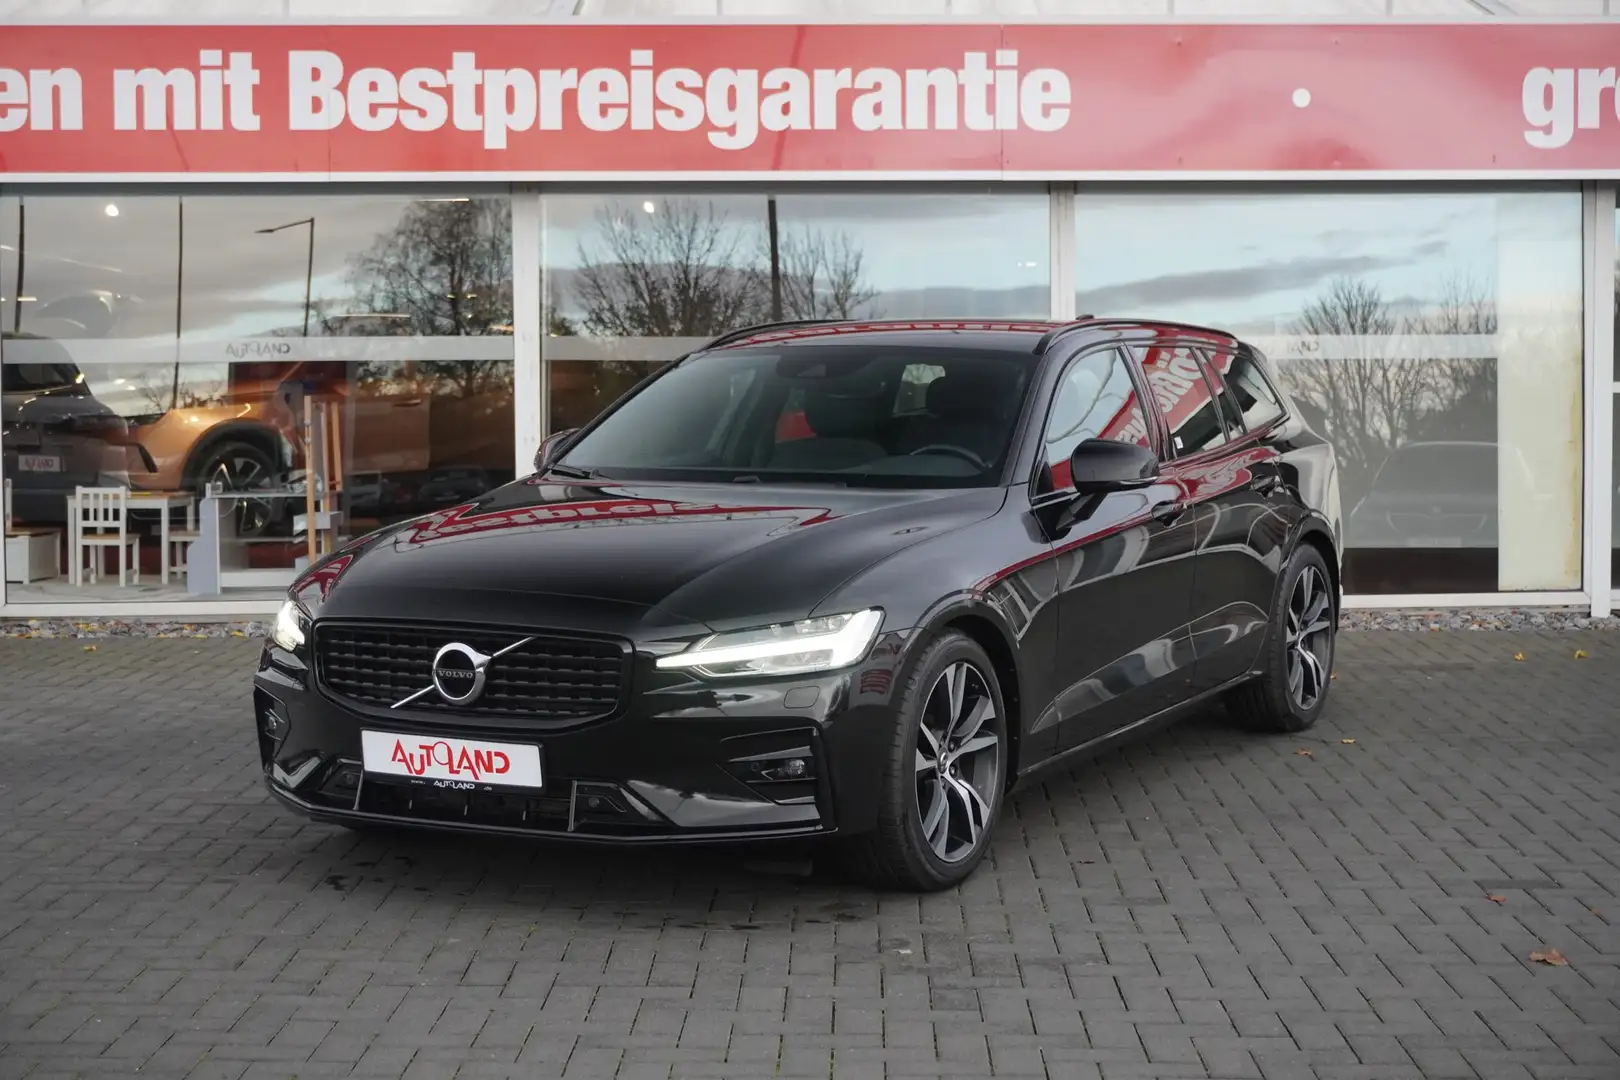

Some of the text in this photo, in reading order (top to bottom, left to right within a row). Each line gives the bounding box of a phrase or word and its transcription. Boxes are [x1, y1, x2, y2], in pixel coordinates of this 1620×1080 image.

[113, 49, 261, 131] mit
[289, 49, 1072, 150] Bestpreisgarantie
[1522, 67, 1620, 149] gr
[438, 671, 473, 679] VOLVO
[391, 738, 511, 781] AUTOLAND
[433, 779, 476, 790] AUTOLAND
